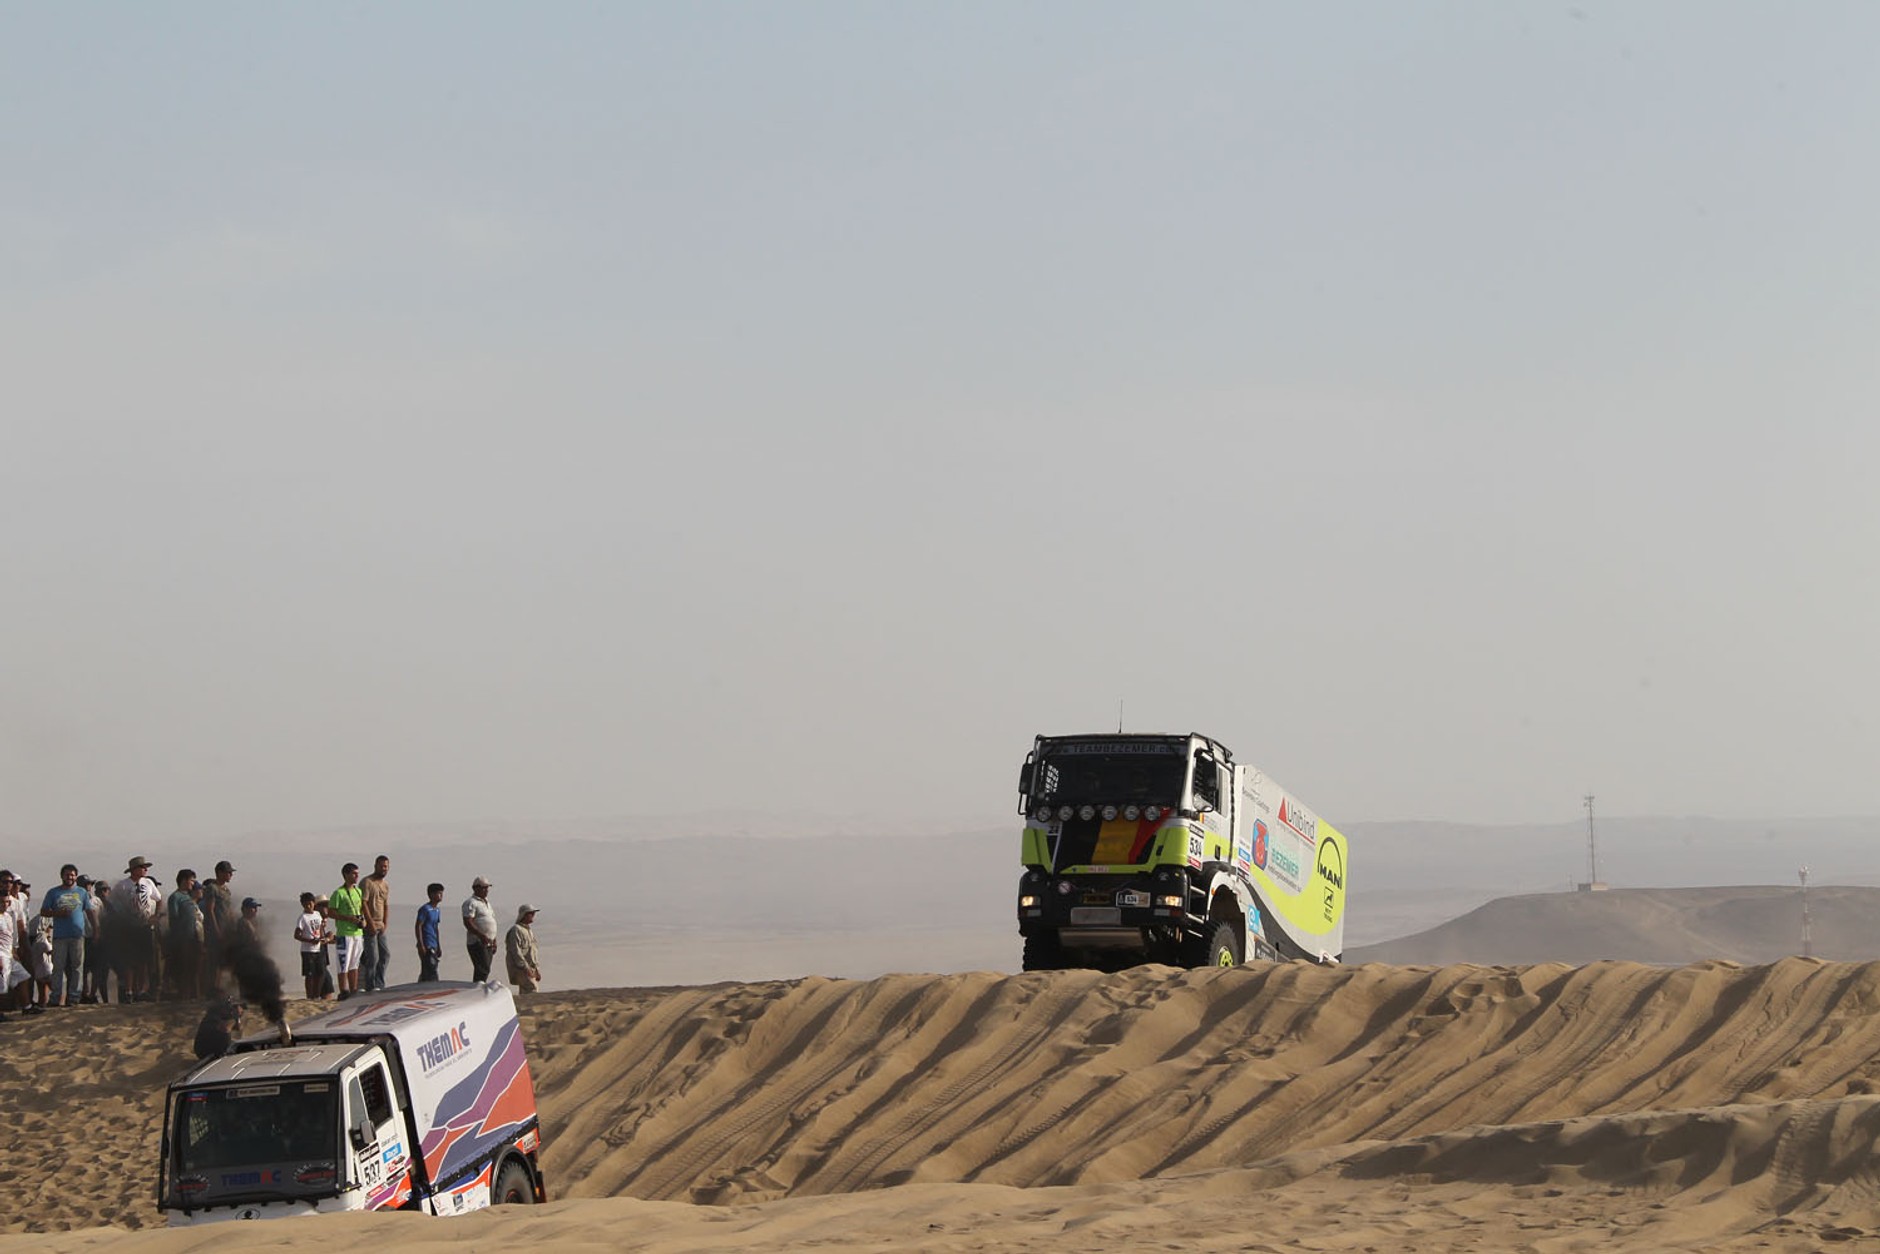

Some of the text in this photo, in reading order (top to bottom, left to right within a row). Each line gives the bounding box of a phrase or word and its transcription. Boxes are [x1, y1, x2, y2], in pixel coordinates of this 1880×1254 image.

[1189, 836, 1203, 859] 534
[1318, 863, 1343, 891] MAN
[416, 1020, 471, 1074] THEMAC
[220, 1167, 283, 1188] THEMAC
[363, 1159, 382, 1186] 537
